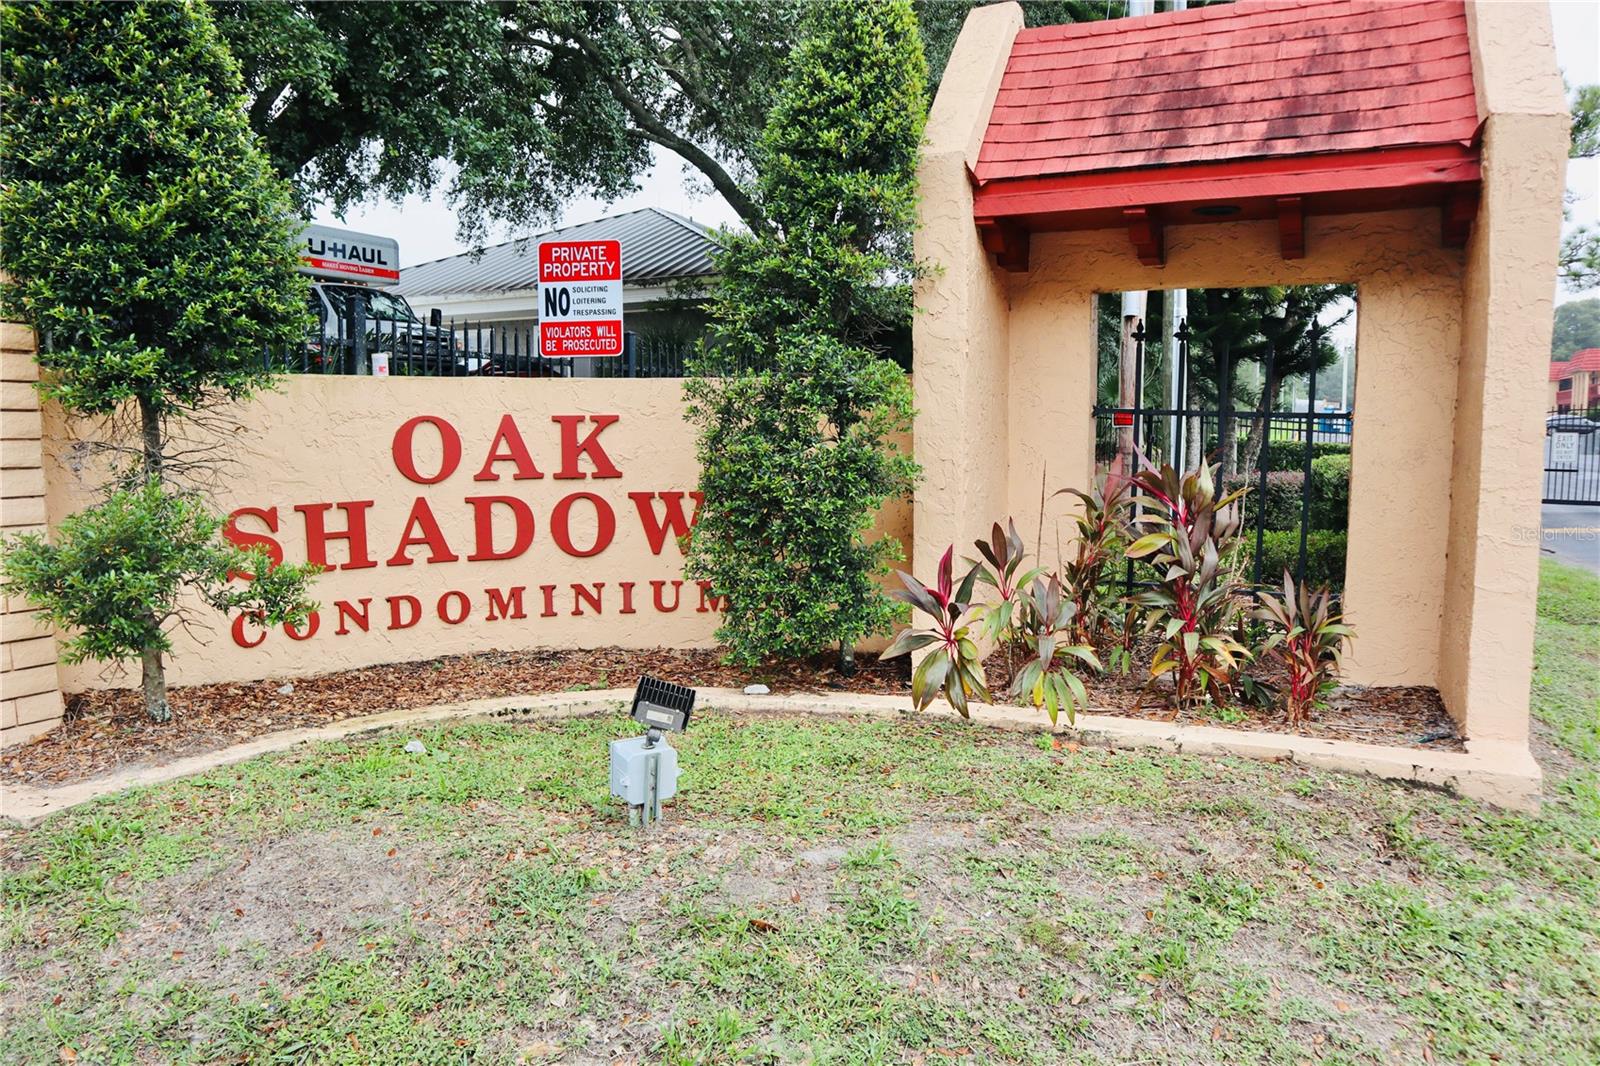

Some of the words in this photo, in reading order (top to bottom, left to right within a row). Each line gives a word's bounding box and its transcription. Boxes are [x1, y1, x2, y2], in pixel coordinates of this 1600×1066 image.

[308, 238, 387, 265] U-HAUL
[552, 246, 607, 261] PRIVATE
[544, 261, 615, 277] PROPERTY
[572, 285, 608, 293] SOLICITING
[545, 287, 570, 317] NO
[572, 297, 606, 305] LOITERING
[573, 308, 617, 316] TRESPASSING
[546, 326, 591, 338] VIOLATORS
[597, 325, 616, 337] WILL
[546, 340, 557, 351] BE
[563, 338, 616, 351] PROSECUTED
[392, 414, 623, 484] OAK
[222, 491, 735, 583] SHADOW
